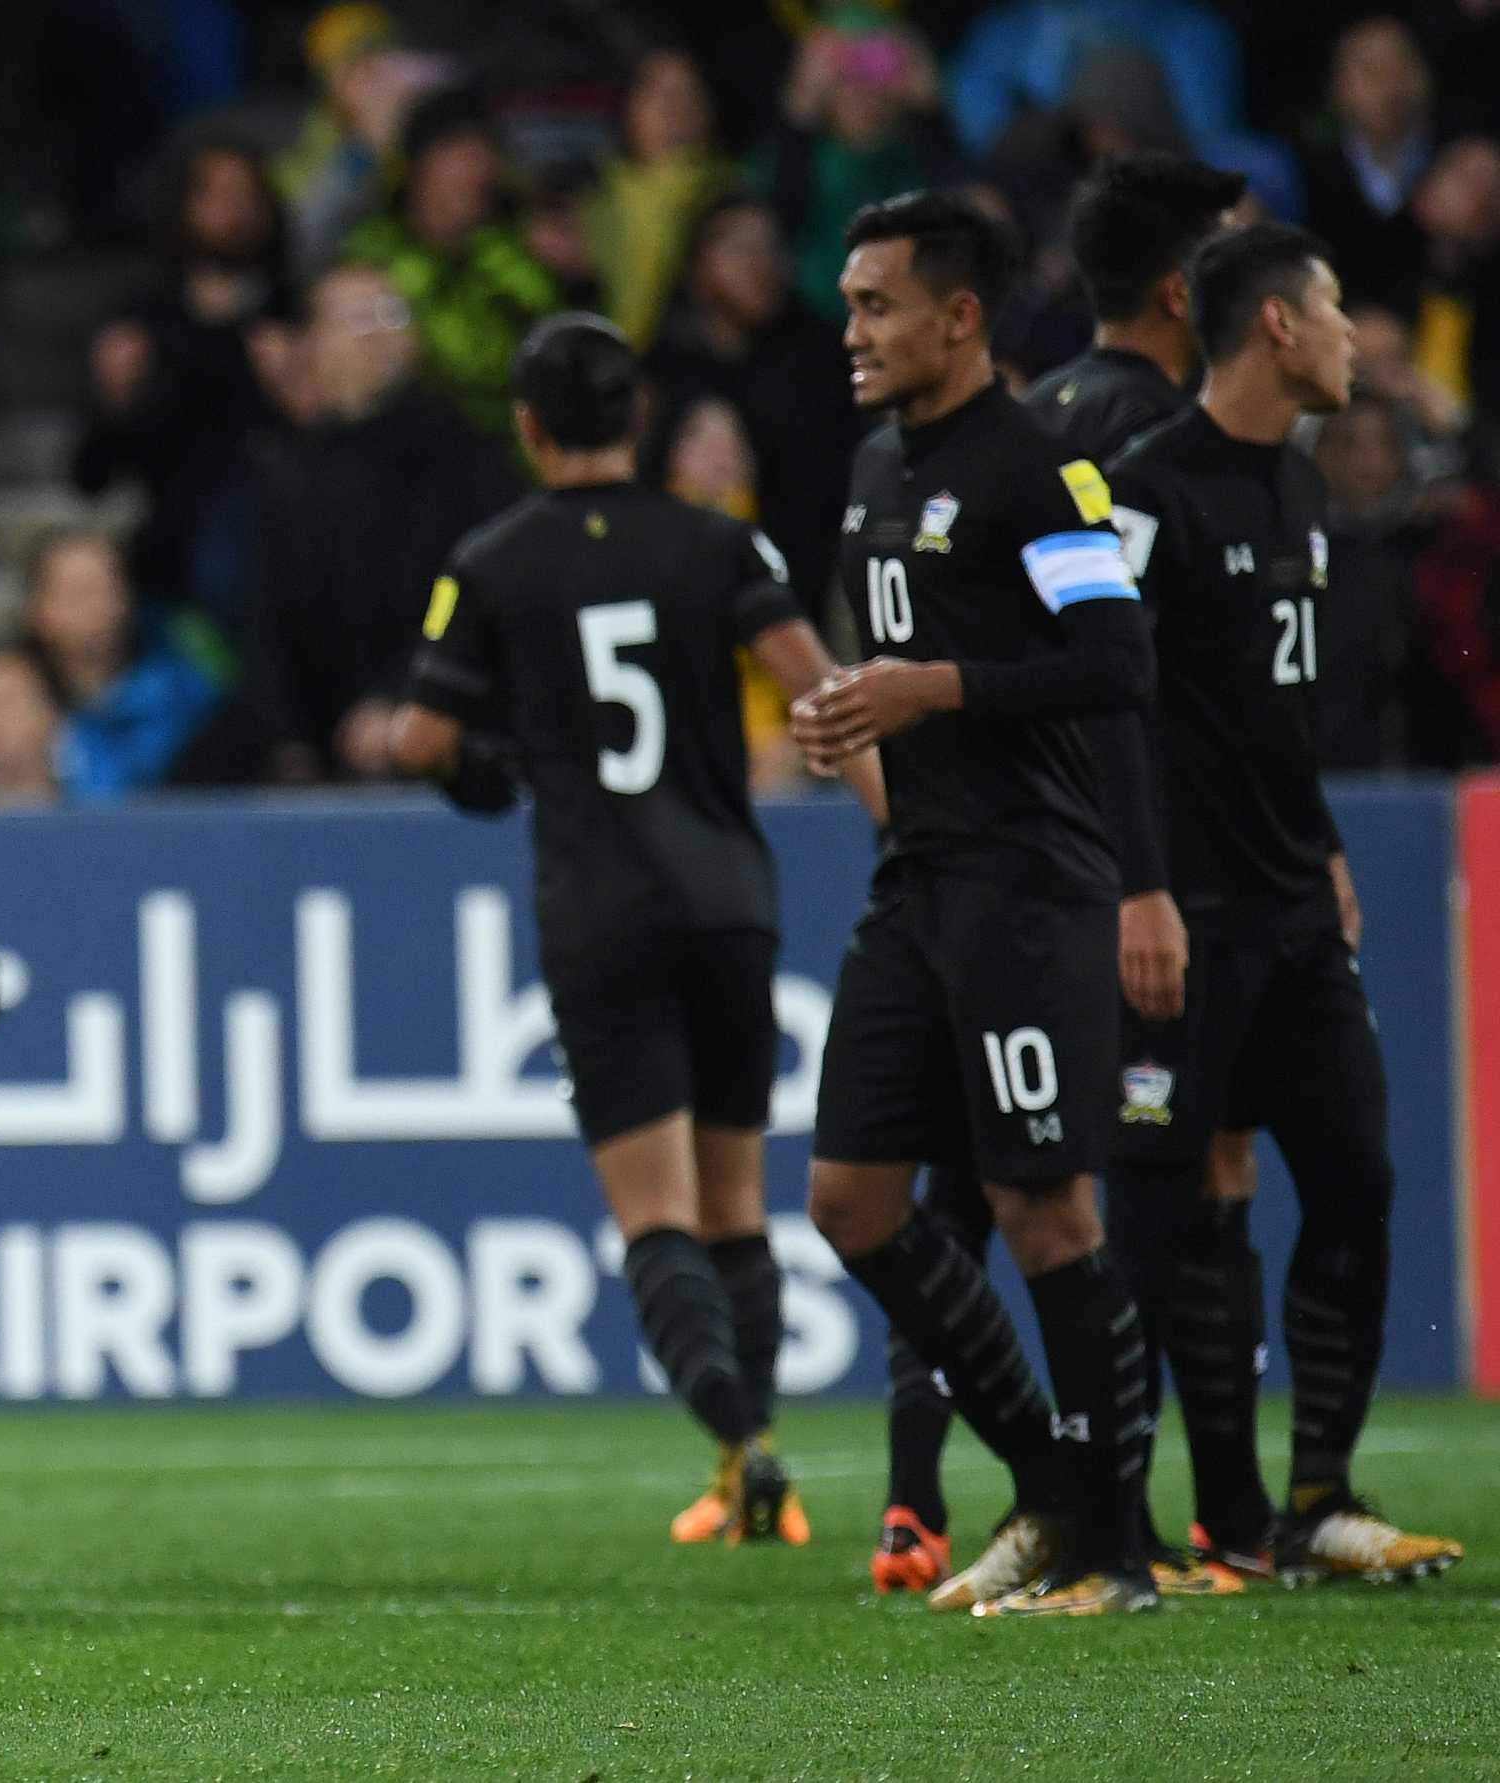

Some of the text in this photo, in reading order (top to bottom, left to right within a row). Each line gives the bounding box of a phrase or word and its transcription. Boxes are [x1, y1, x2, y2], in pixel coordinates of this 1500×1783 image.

[867, 557, 913, 643] 10
[1271, 596, 1317, 685] 21
[577, 599, 666, 795] 5
[982, 1026, 1059, 1114] 10
